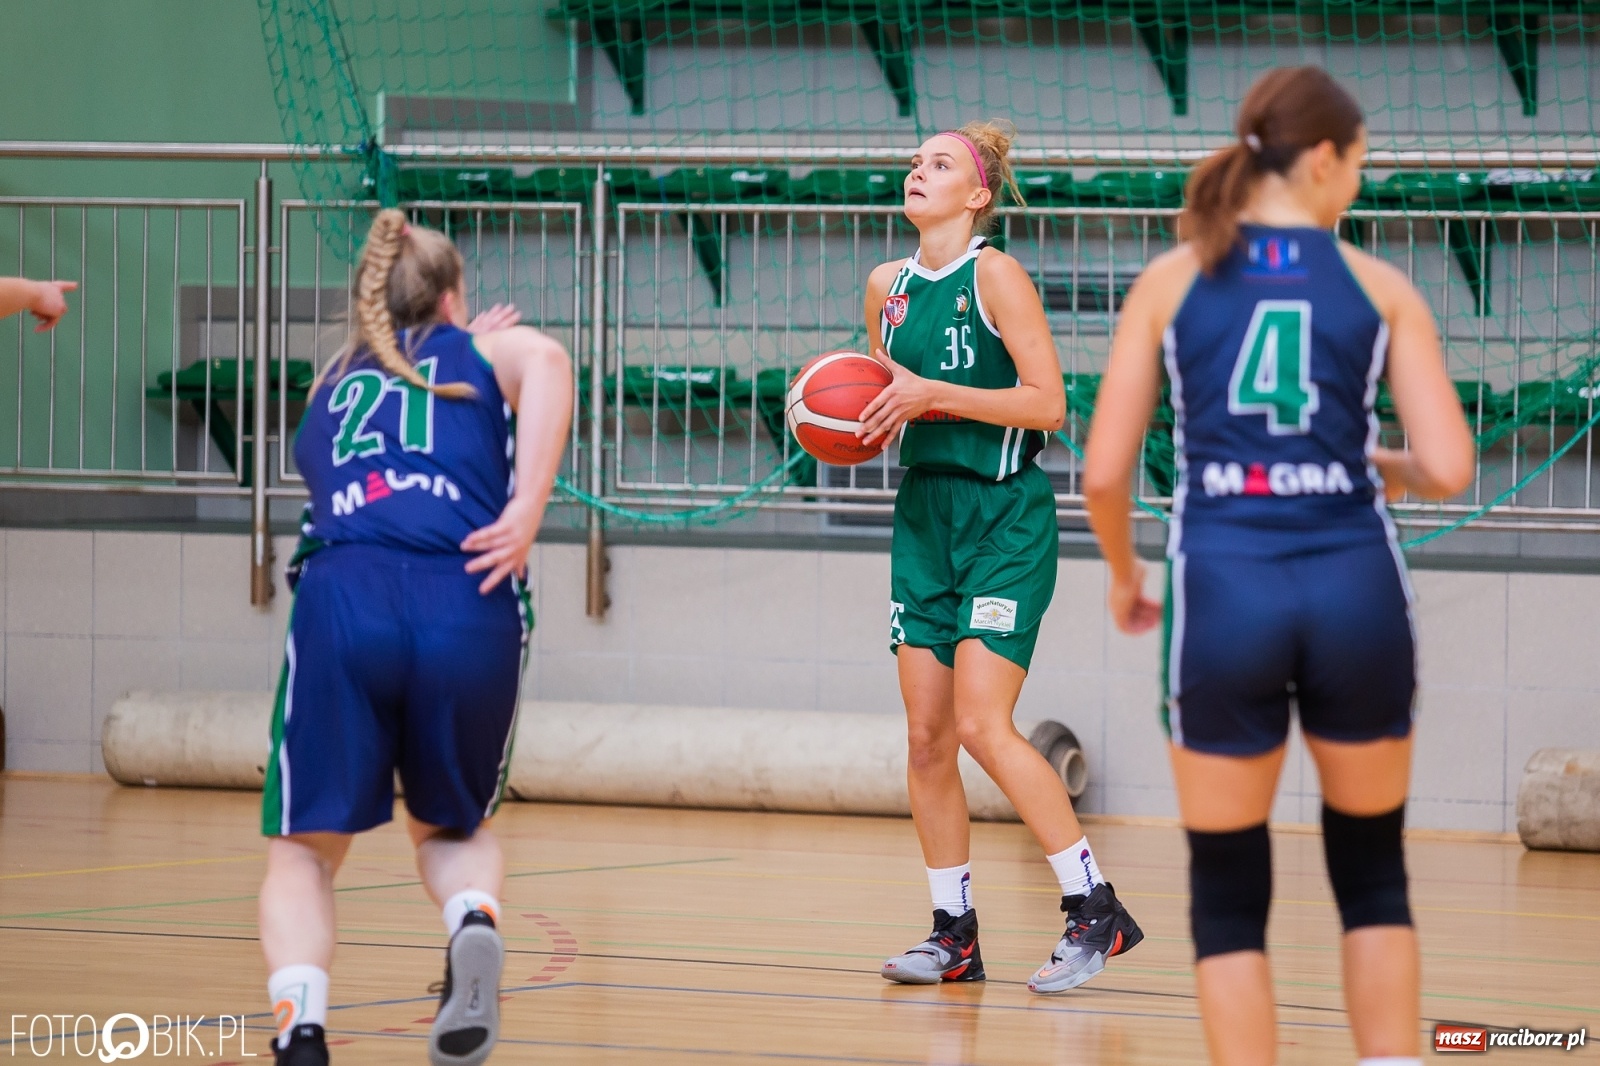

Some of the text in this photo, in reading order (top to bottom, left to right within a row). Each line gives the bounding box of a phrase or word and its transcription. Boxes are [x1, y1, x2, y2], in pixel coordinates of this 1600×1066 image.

[941, 325, 975, 369] 35
[1228, 300, 1320, 435] 4
[328, 356, 438, 467] 21
[1203, 462, 1353, 496] MAGRA
